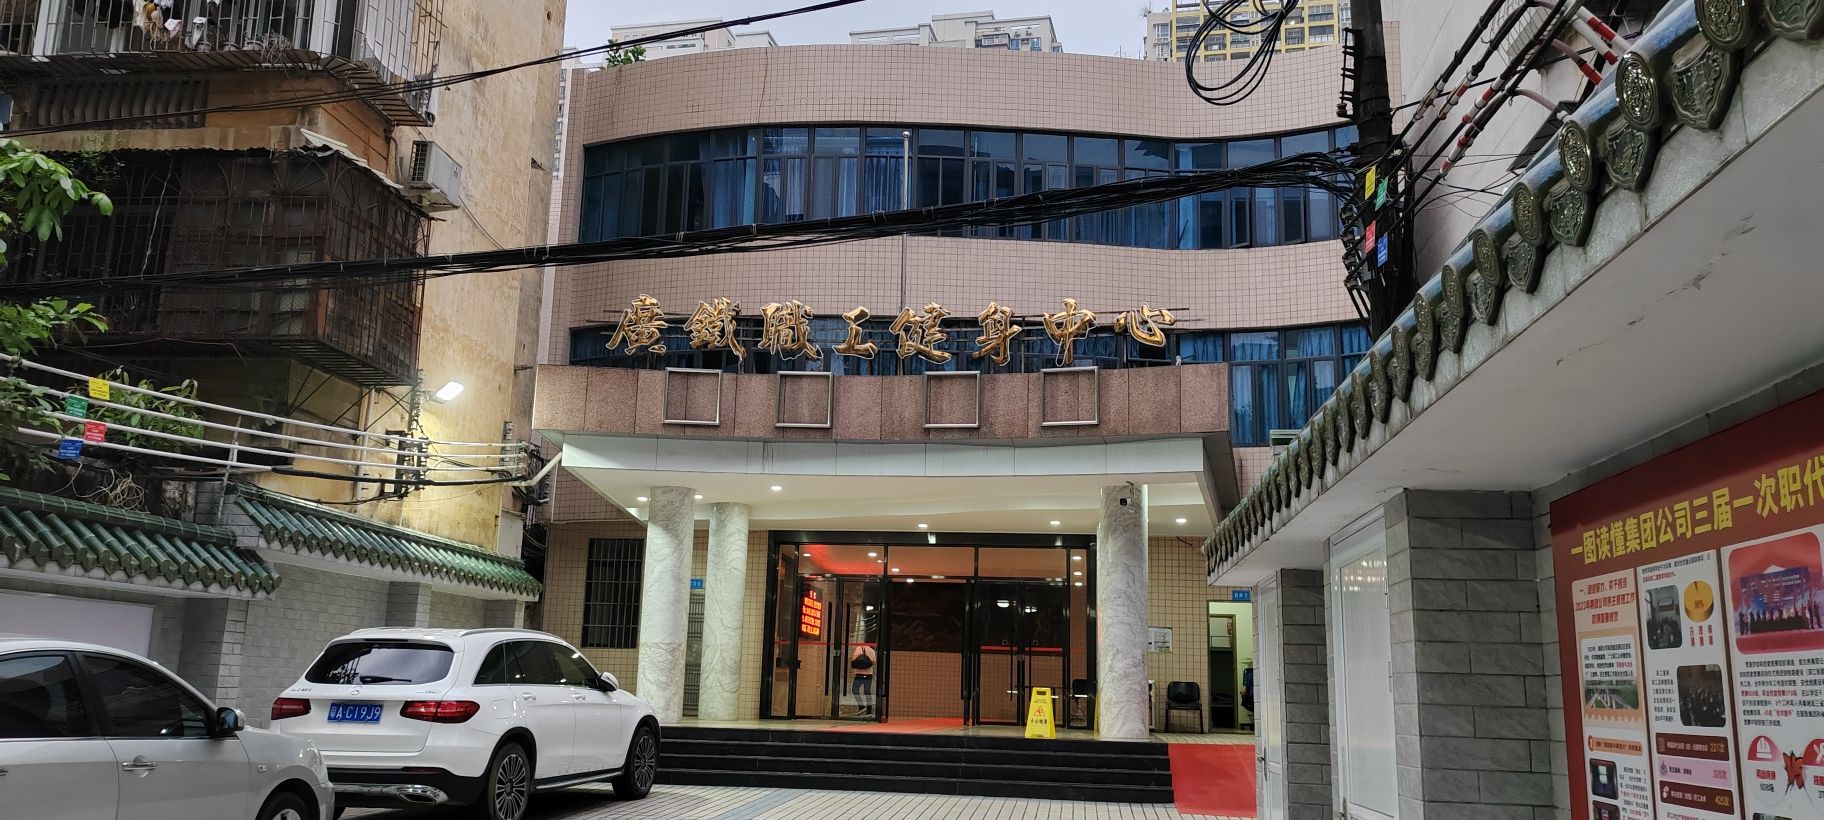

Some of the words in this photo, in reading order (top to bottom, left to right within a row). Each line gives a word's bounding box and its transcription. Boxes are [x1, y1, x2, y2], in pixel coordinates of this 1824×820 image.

[606, 294, 1176, 367] 廣鐵職工健身中心
